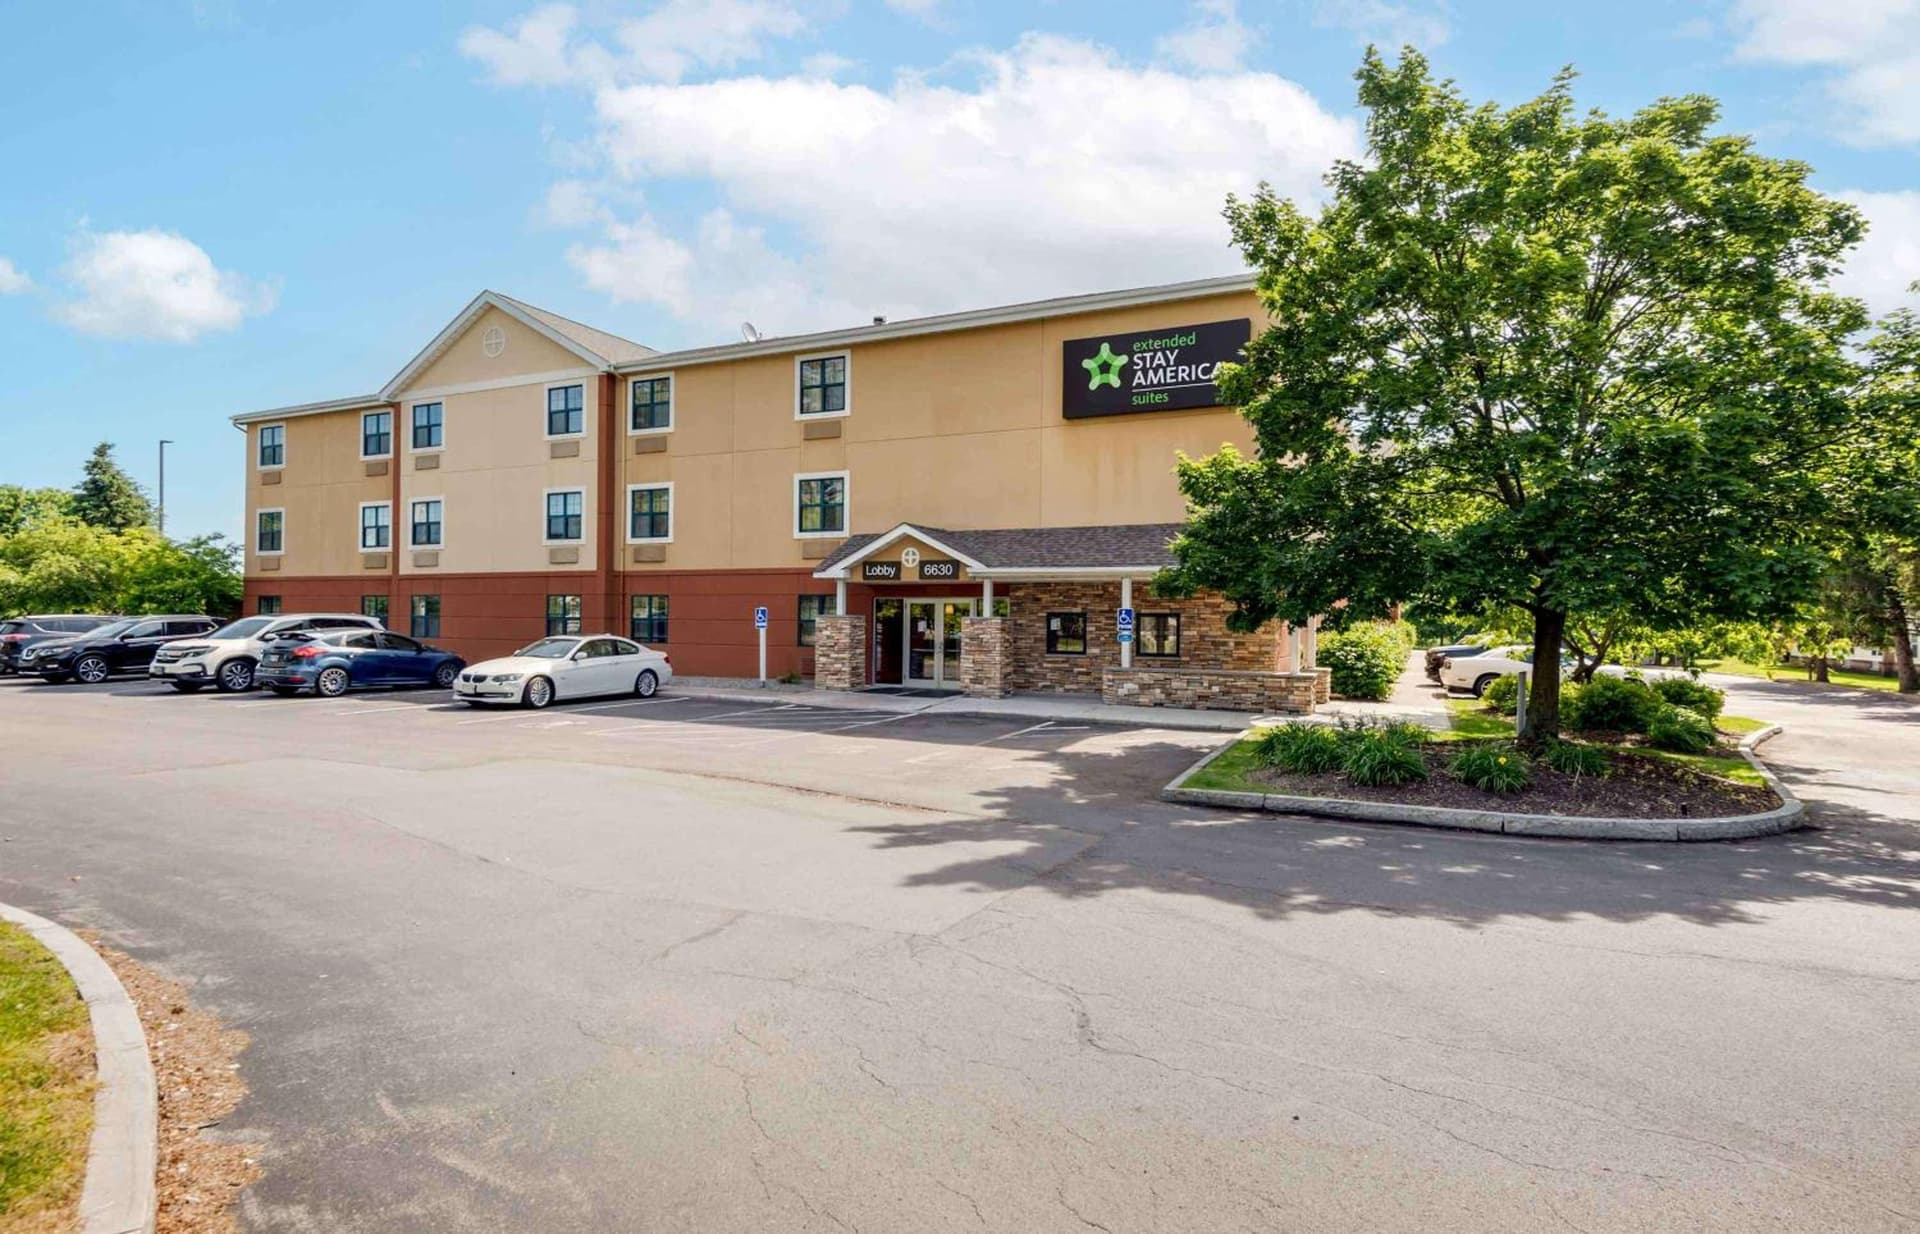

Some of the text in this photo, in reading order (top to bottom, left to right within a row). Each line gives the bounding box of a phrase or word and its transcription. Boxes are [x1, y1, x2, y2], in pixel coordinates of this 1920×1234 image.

[1133, 332, 1196, 351] extended
[1132, 350, 1179, 369] STAY
[1132, 391, 1169, 405] suites
[866, 565, 896, 578] Lobby
[924, 564, 953, 576] 6630
